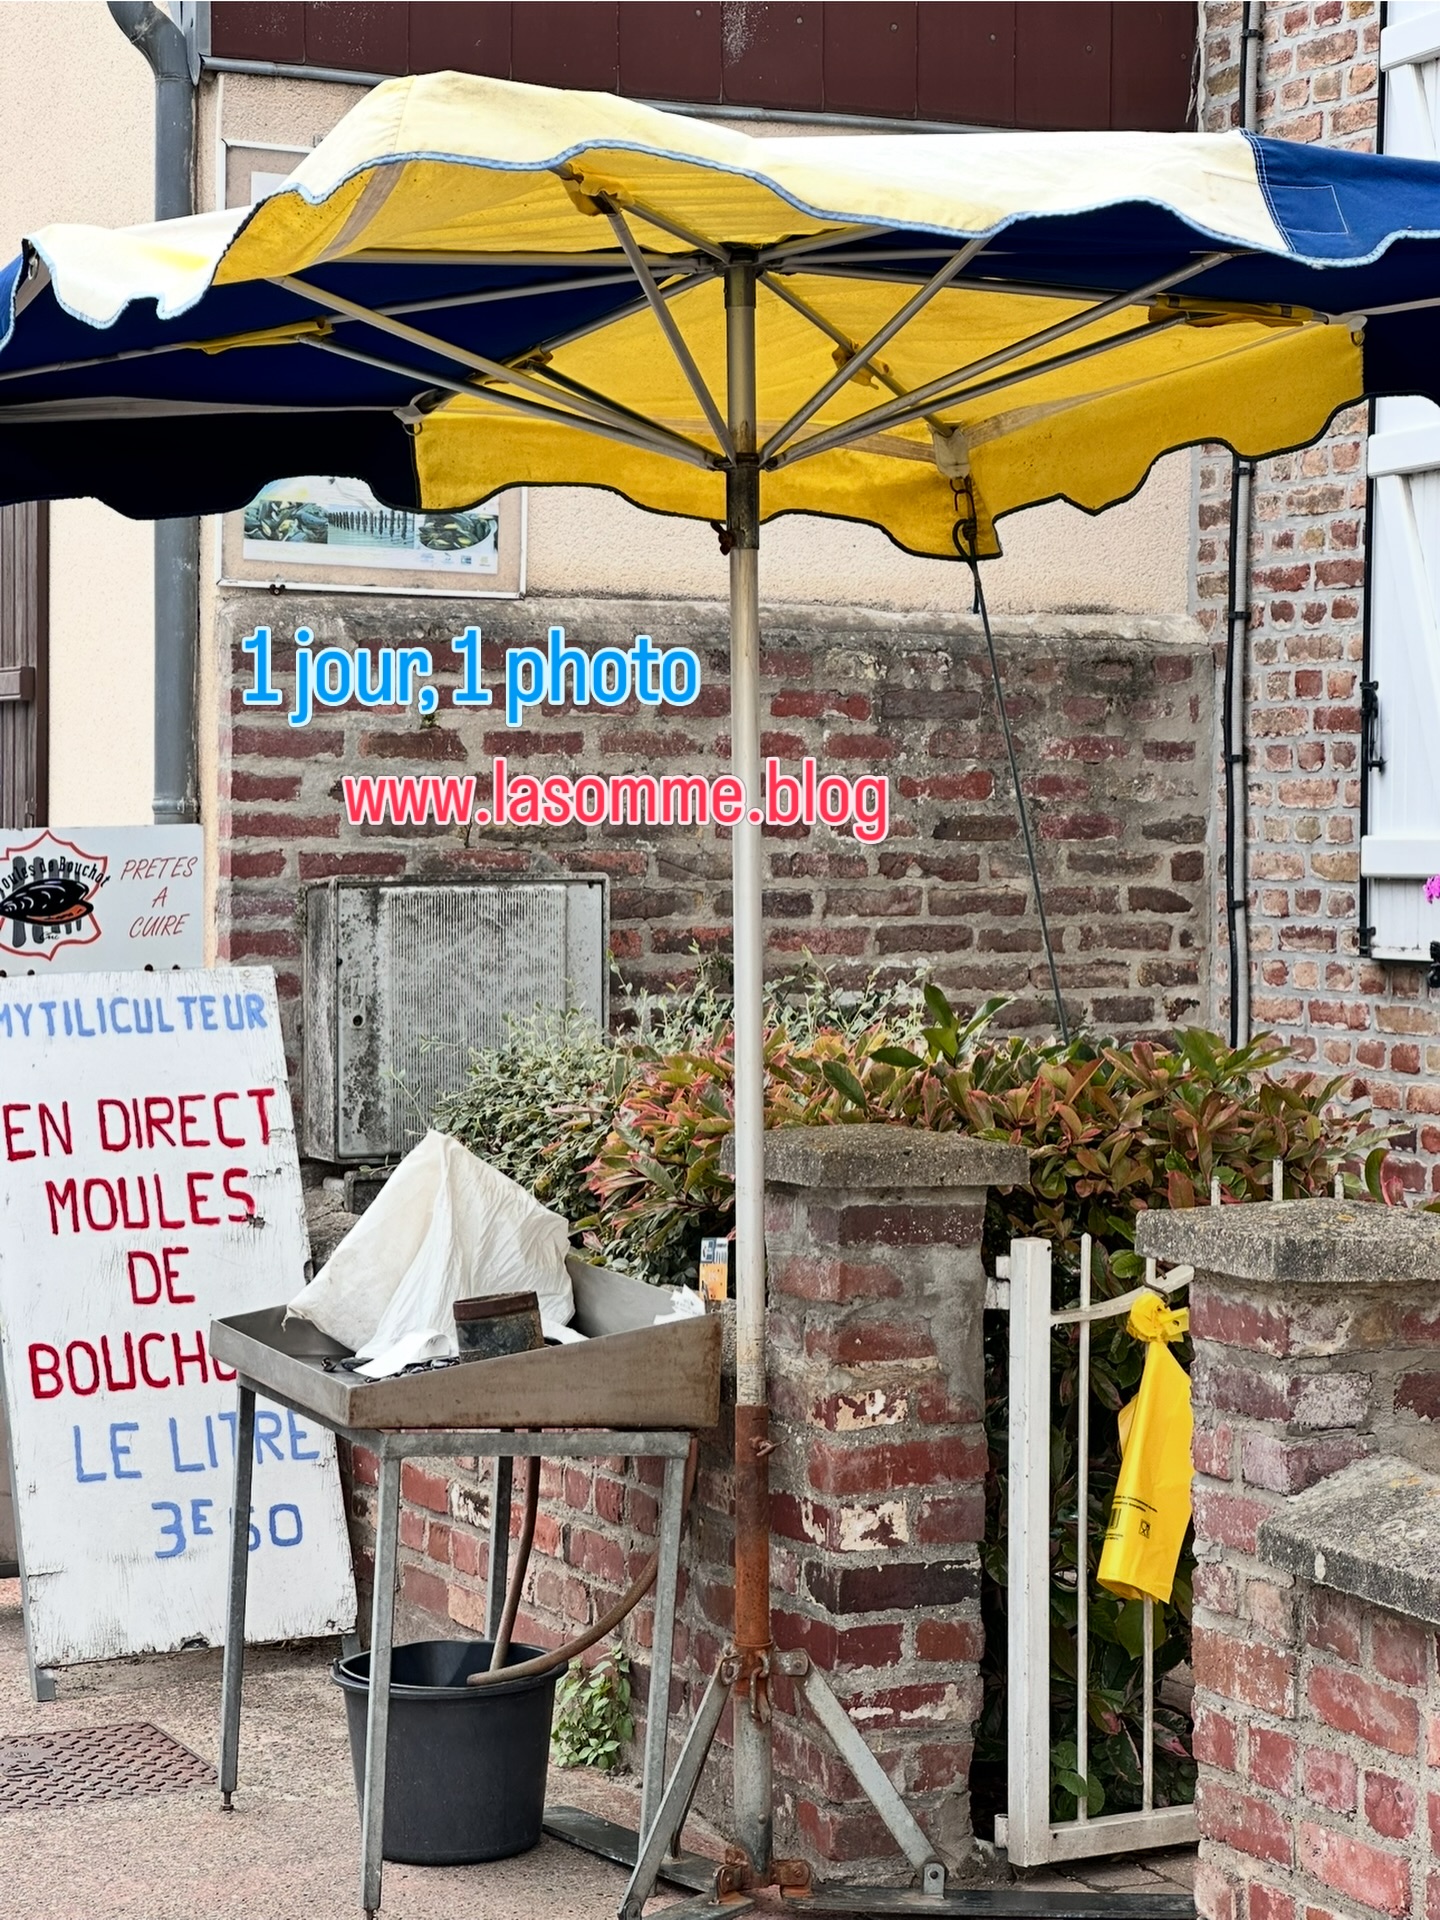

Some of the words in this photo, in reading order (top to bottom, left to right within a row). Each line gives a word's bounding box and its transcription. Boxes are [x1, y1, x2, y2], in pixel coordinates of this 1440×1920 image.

[0, 865, 36, 900] oules
[39, 857, 55, 874] de
[59, 856, 111, 888] Bouchot
[120, 856, 198, 880] PRETES
[129, 913, 191, 938] CUIRE
[152, 886, 168, 908] A
[3, 1102, 73, 1161] EN
[97, 1088, 275, 1152] DIRECT
[45, 1168, 256, 1235] MOULES
[127, 1247, 195, 1304] DE
[28, 1330, 237, 1399] BOUCH
[73, 1422, 142, 1483] LE
